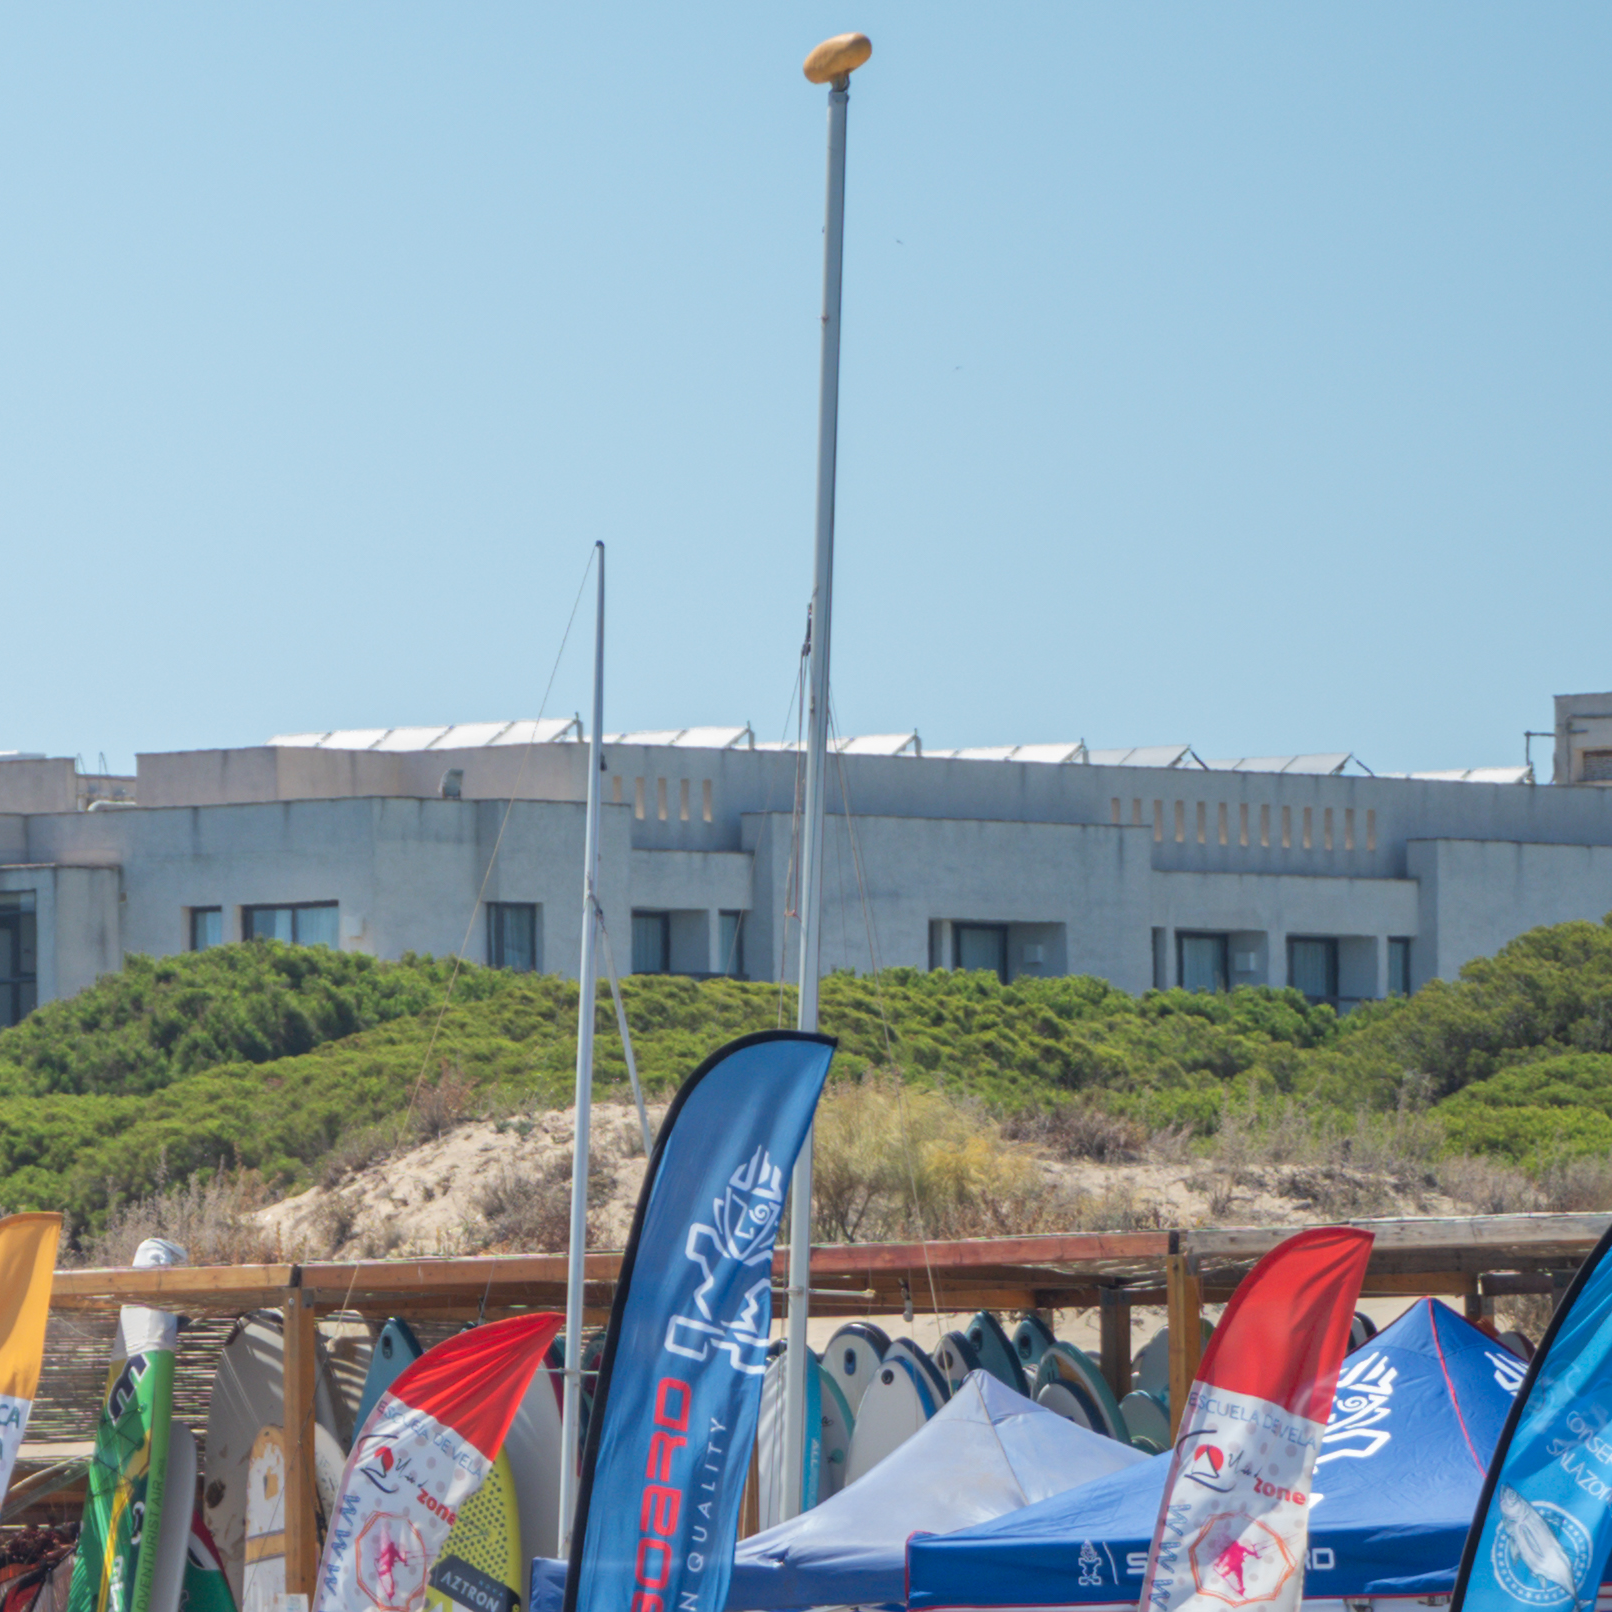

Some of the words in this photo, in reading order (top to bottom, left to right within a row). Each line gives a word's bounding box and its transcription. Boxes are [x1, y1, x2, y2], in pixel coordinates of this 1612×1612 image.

[1189, 1391, 1260, 1426] ESCUELA
[1279, 1423, 1317, 1450] VELA
[151, 1479, 164, 1507] AIR
[417, 1488, 457, 1526] zone
[688, 1417, 727, 1574] QUALITY
[1254, 1477, 1307, 1506] zone
